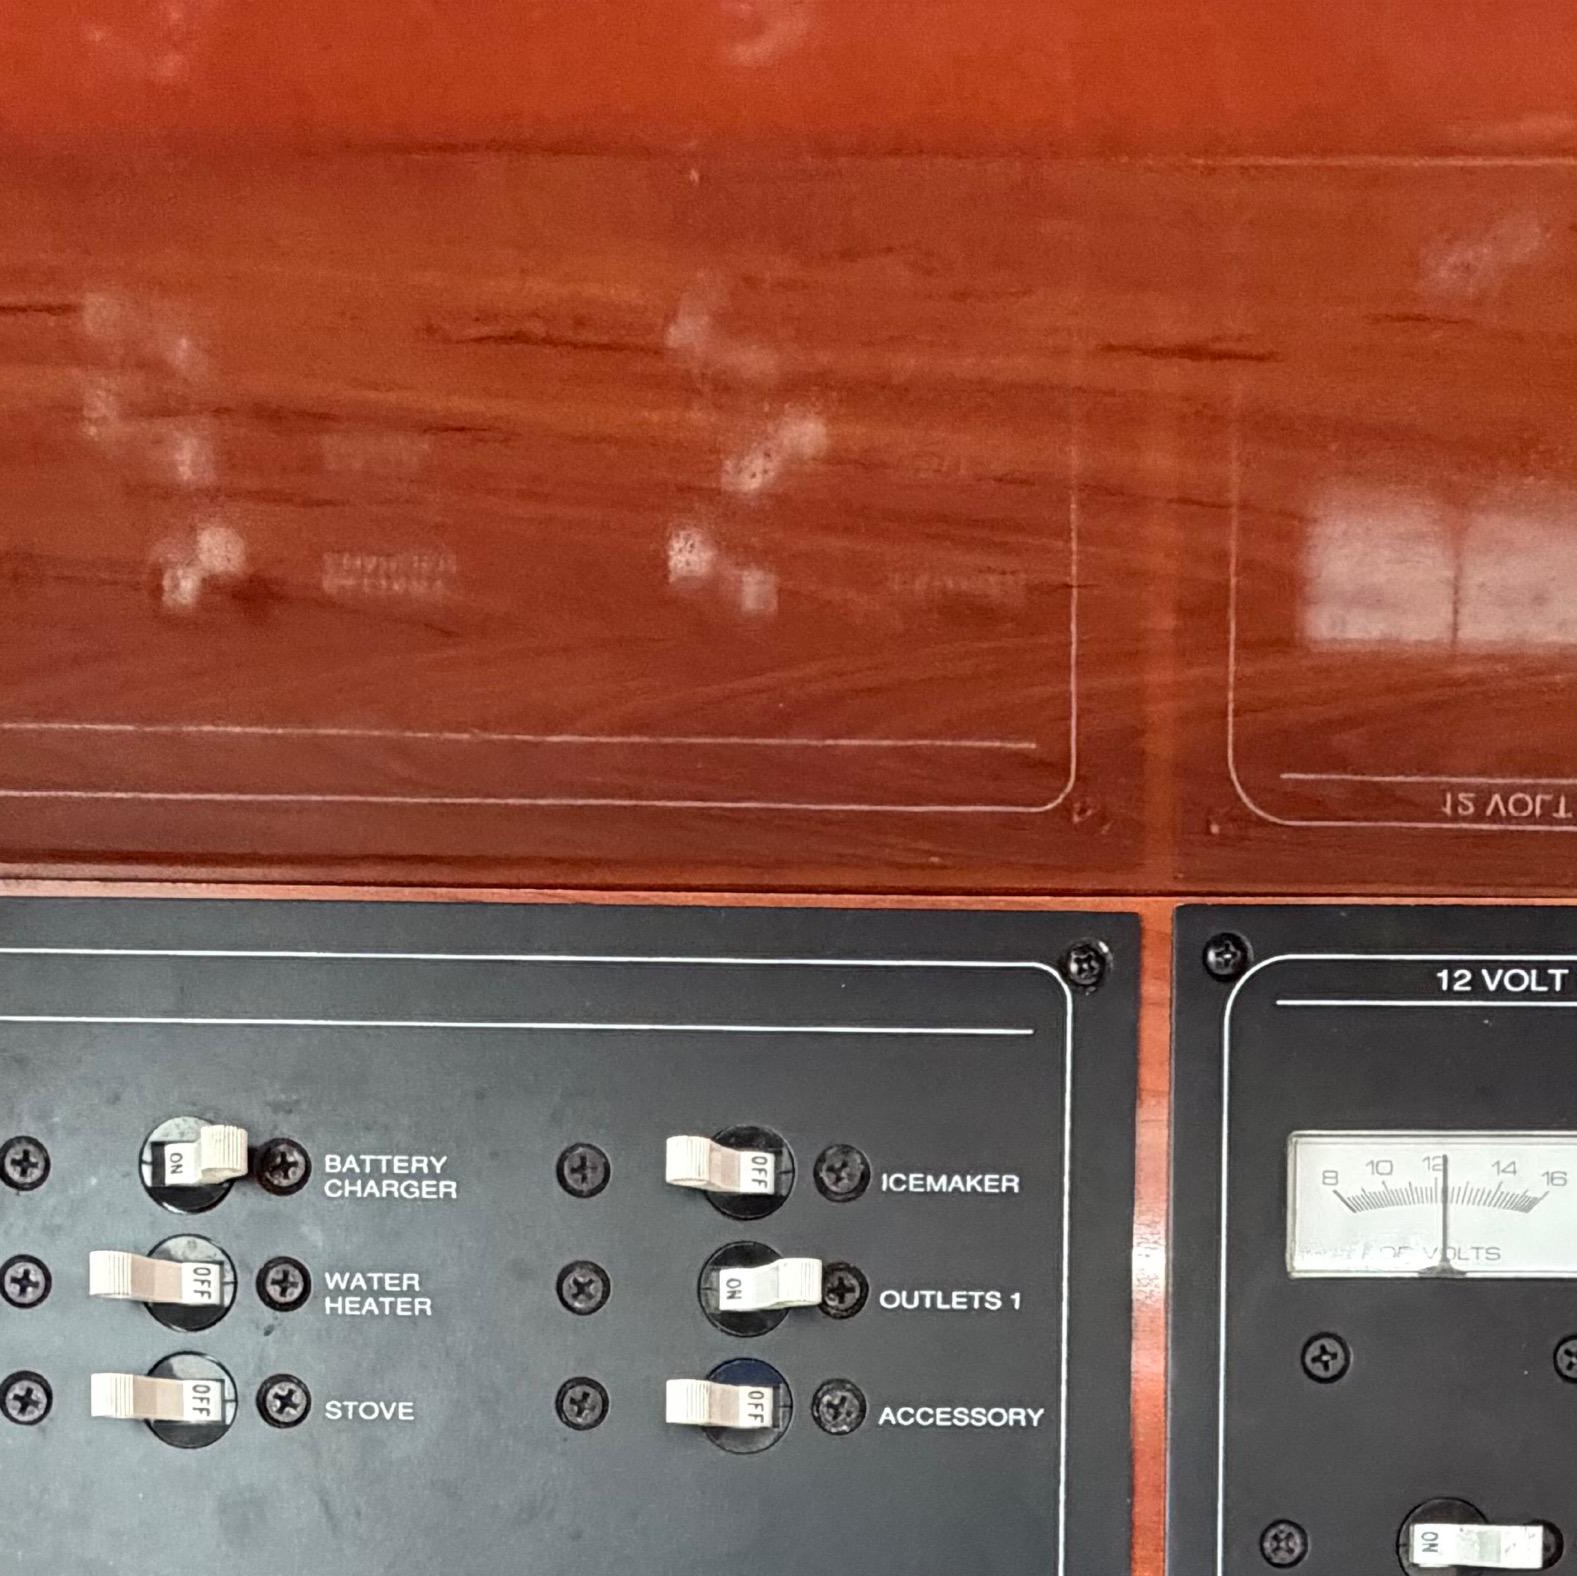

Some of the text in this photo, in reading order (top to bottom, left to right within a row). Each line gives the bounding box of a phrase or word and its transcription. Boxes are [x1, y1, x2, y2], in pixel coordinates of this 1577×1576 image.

[1436, 968, 1473, 991] 12
[1480, 968, 1570, 992] VOLT
[170, 1152, 184, 1175] ON
[324, 1153, 448, 1174] BATTERY
[1321, 1159, 1568, 1188] 8 10 14 16
[323, 1178, 458, 1199] CHARGER
[881, 1172, 1020, 1193] ICEMAKER
[193, 1266, 212, 1300] OFF
[323, 1271, 421, 1291] WATER
[726, 1278, 742, 1300] ON
[324, 1296, 433, 1316] HEATER
[878, 1289, 1021, 1310] OUTLETS 1
[192, 1384, 211, 1417] OFF
[324, 1400, 416, 1420] STOVE
[877, 1406, 1045, 1427] ACCESSORY
[1420, 1531, 1439, 1553] ON
